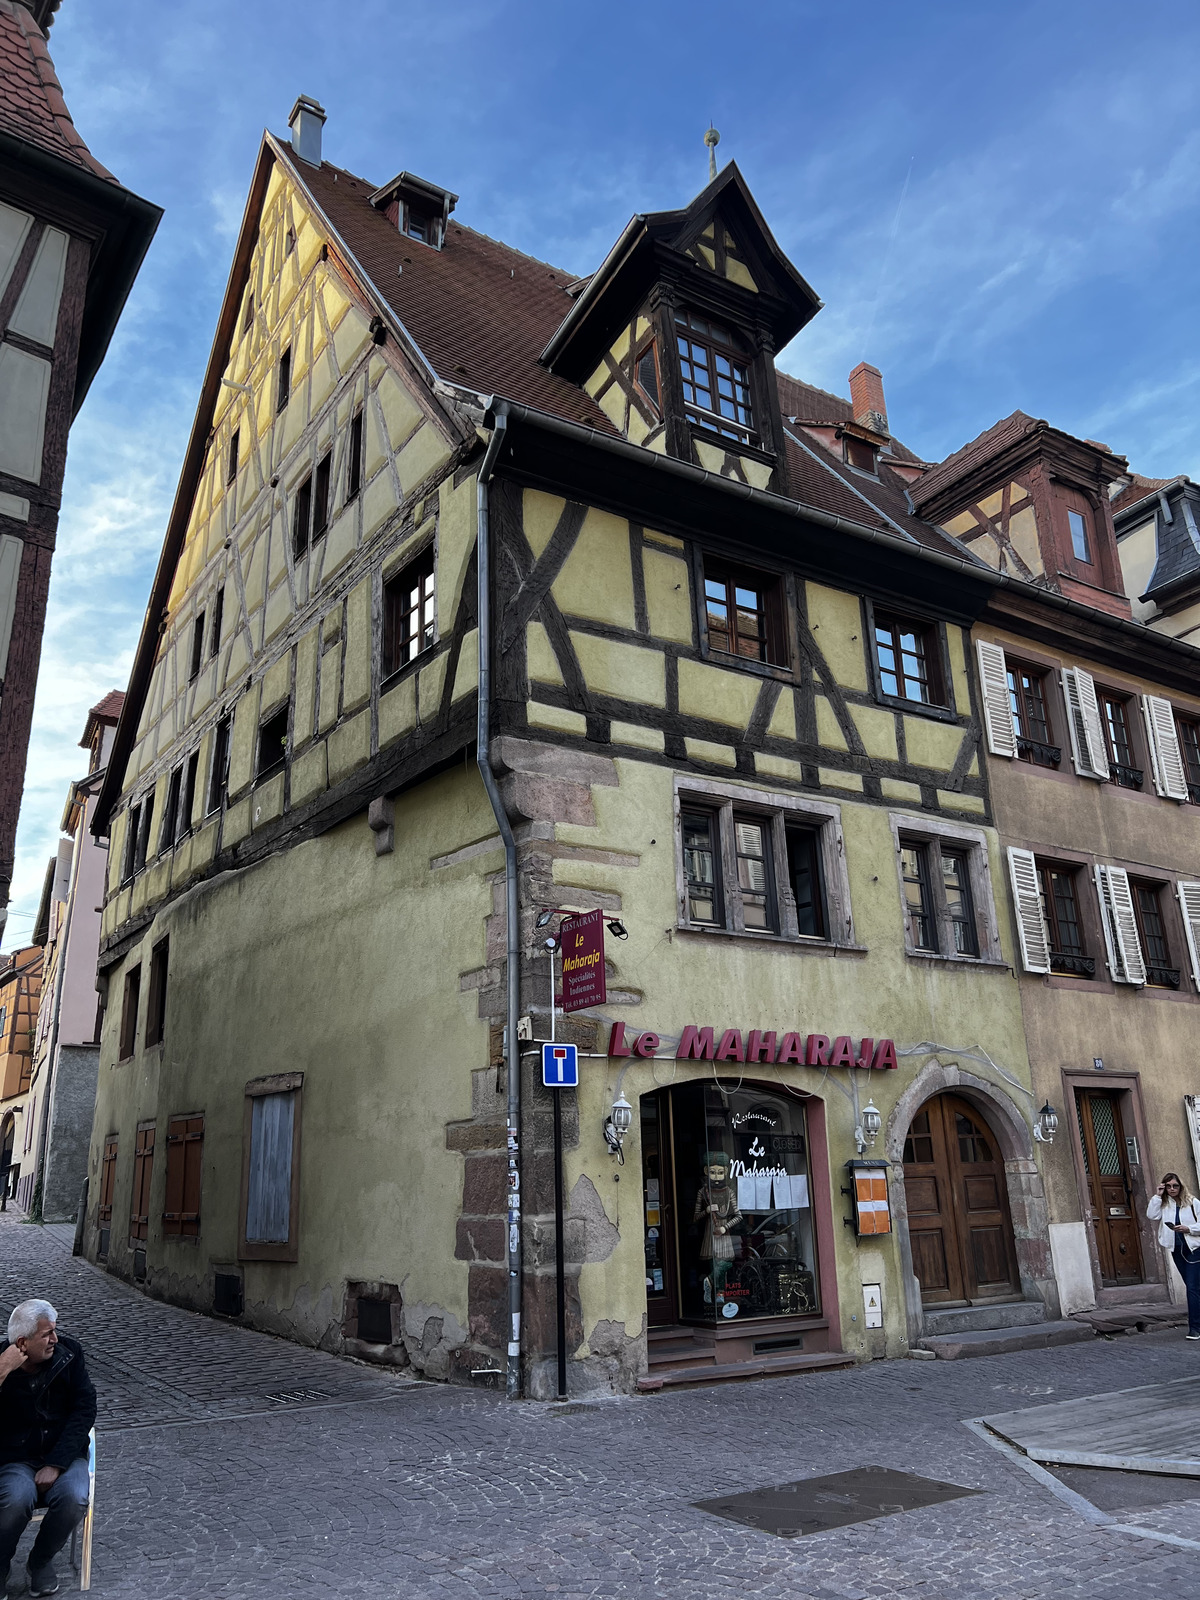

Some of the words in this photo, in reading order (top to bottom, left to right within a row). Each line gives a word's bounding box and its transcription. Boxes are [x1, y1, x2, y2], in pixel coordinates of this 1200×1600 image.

[562, 912, 599, 933] RESTAURANT
[575, 933, 584, 947] Le
[563, 949, 600, 972] Maharaja
[568, 970, 596, 985] Spécialités
[569, 983, 595, 996] Indiennes
[608, 1021, 660, 1058] Le
[676, 1025, 898, 1070] MAHARAJA
[731, 1111, 777, 1129] Restaurant
[748, 1136, 766, 1157] Le
[729, 1158, 788, 1184] Maharaja
